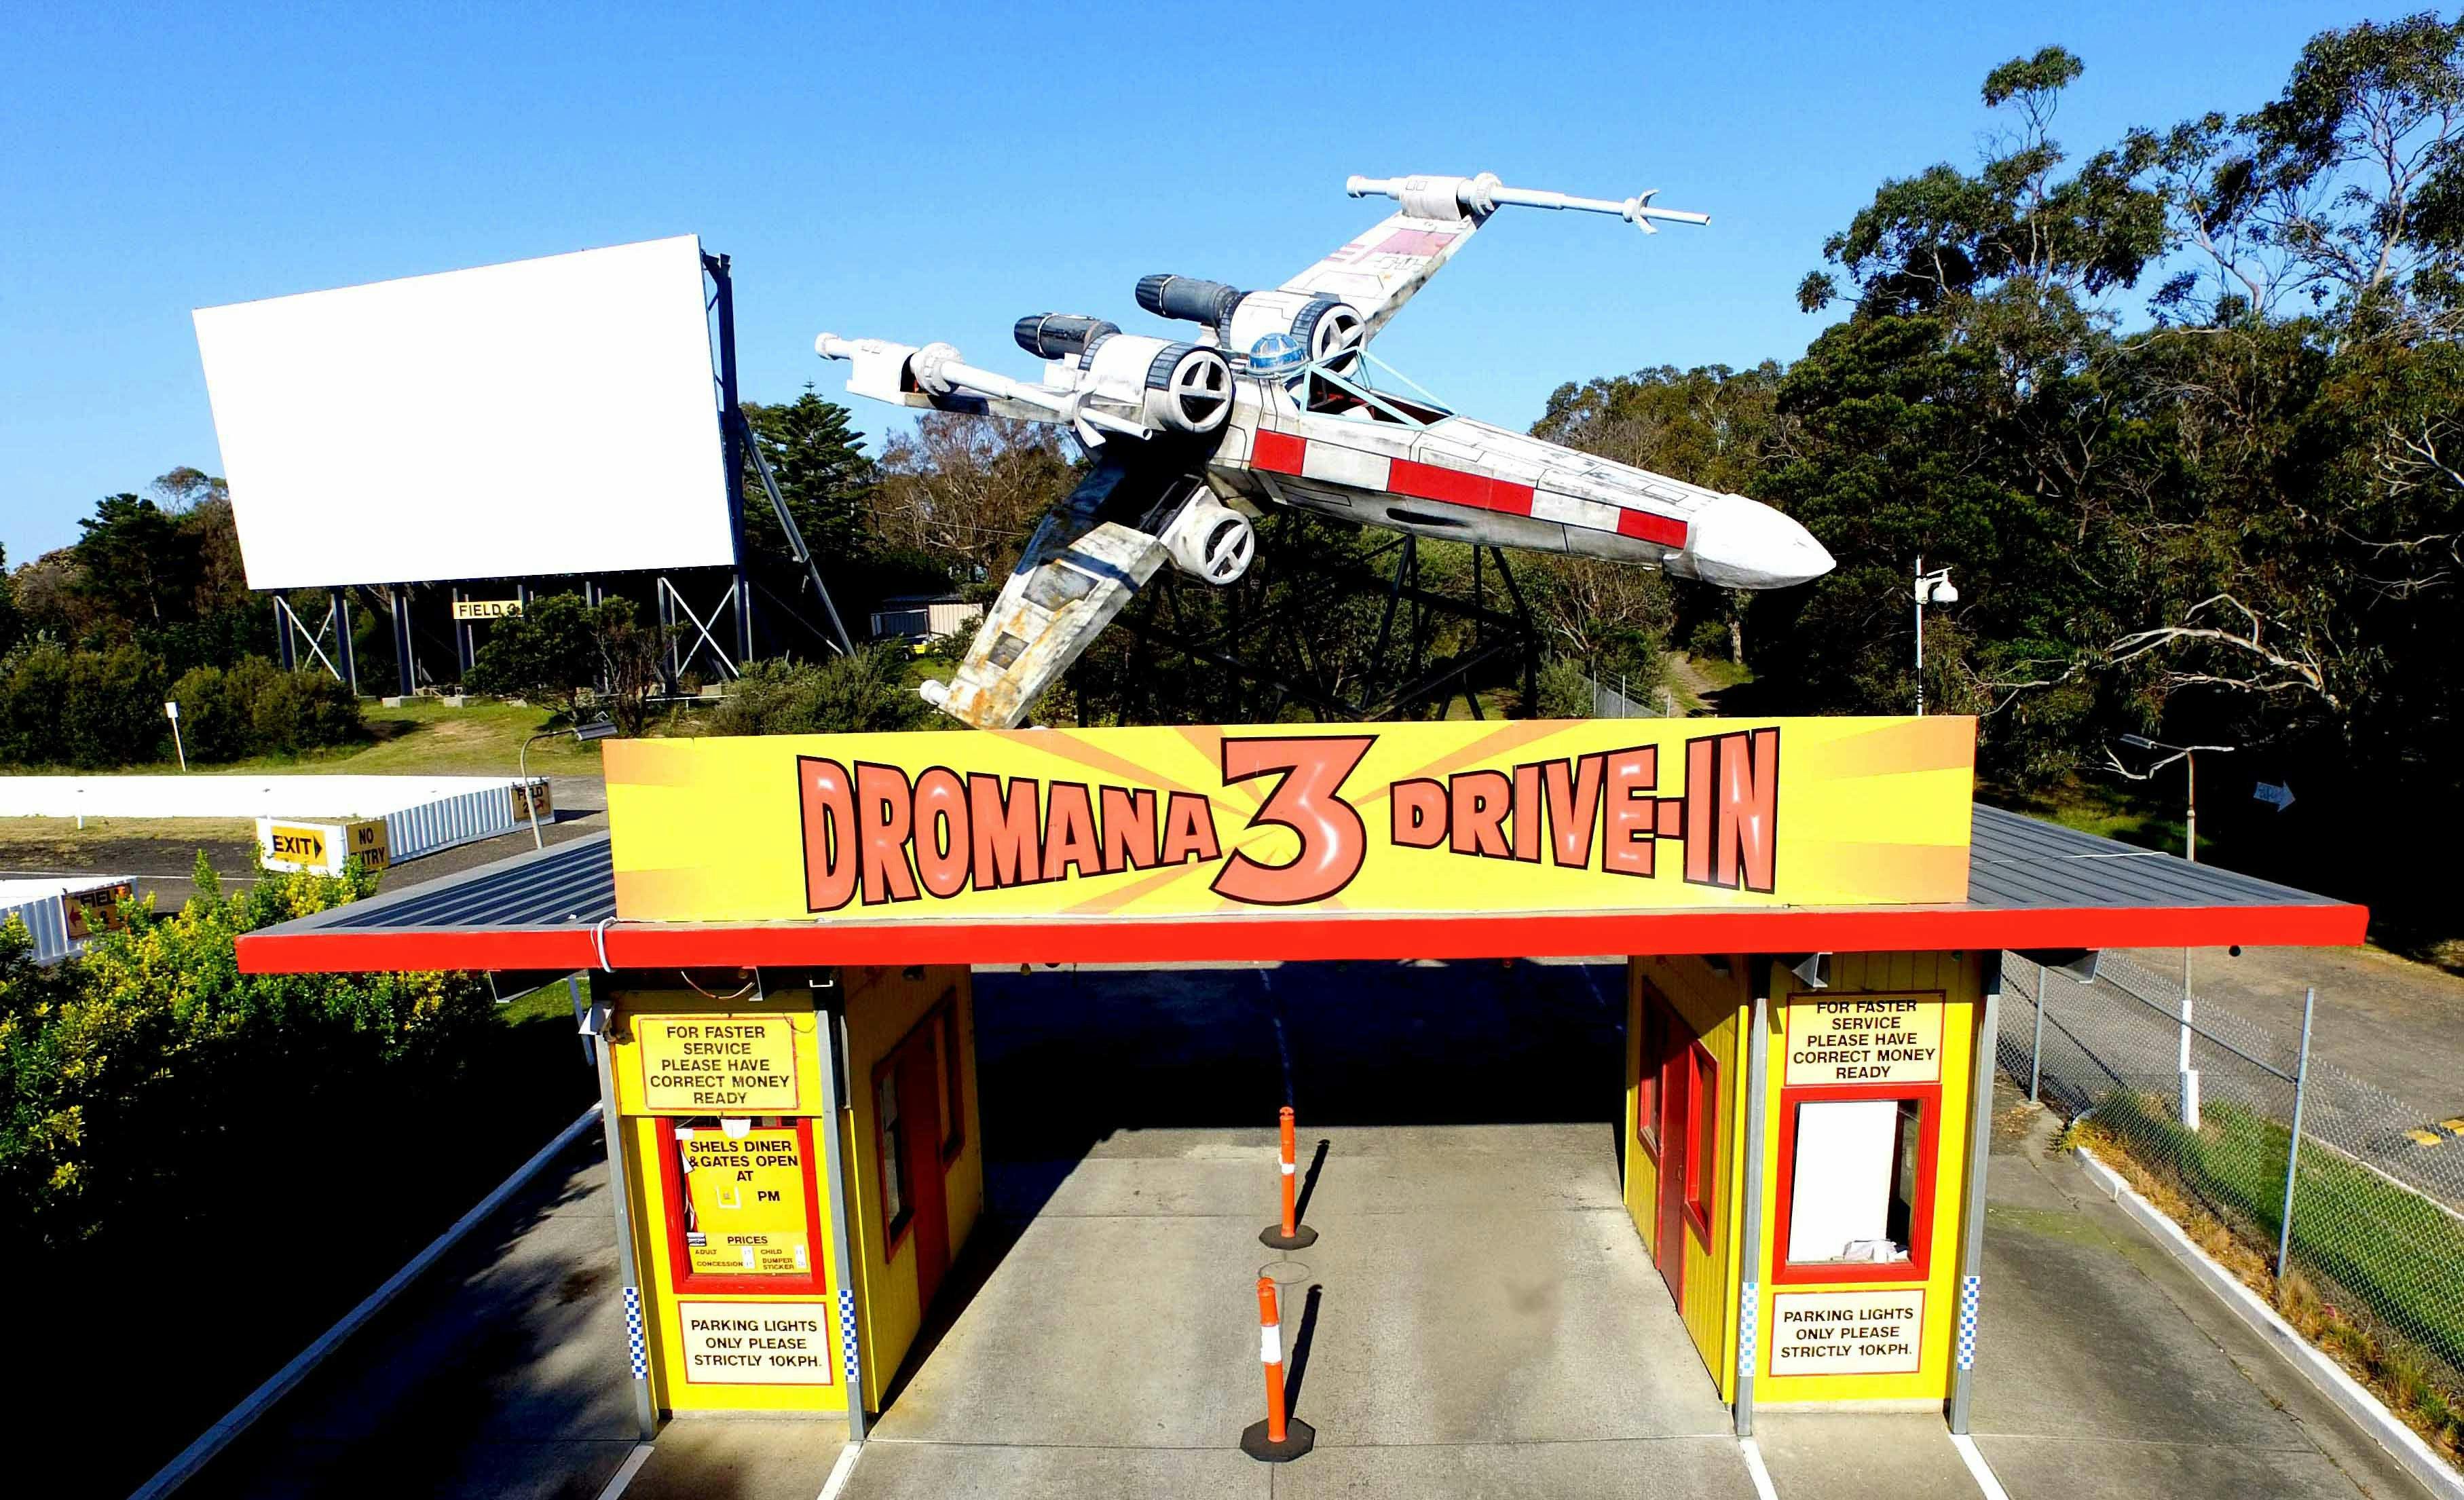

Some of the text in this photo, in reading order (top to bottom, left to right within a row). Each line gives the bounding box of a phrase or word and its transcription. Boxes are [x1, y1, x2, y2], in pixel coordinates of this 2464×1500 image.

[459, 603, 501, 617] FIELD
[517, 786, 544, 800] FILD
[797, 726, 1780, 914] DROMANA 3 DRIVE-IN
[358, 827, 374, 844] NO
[272, 835, 312, 855] EXIT
[350, 847, 385, 866] TRY
[1817, 999, 1917, 1014] FOR FASTER
[1832, 1016, 1901, 1030] SERVICE
[667, 1026, 765, 1038] FOR FASTER
[1808, 1032, 1918, 1047] PLEASE HAVE
[684, 1043, 751, 1055] SERVICE
[1793, 1048, 1936, 1064] CORRECT MONEY
[662, 1059, 770, 1071] PLEASE HAVE
[1836, 1066, 1891, 1079] READY
[650, 1075, 789, 1087] CORRECT MONEY
[694, 1092, 747, 1104] READY
[690, 1140, 792, 1152] SHELS DINER
[755, 1155, 798, 1167] OPEN
[736, 1170, 753, 1182] AT
[758, 1190, 781, 1201] PM
[727, 1236, 768, 1245] PRICES
[1784, 1308, 1914, 1323] PARKING LIGHTS
[691, 1319, 817, 1332] PARKING LIGHTS
[1796, 1326, 1900, 1340] ONLY PLEASE
[706, 1338, 807, 1349] ONLY PLEASE
[1781, 1344, 1912, 1357] STRICTLY 10KPH.
[694, 1355, 822, 1366] STRICTLY 10KPH.
